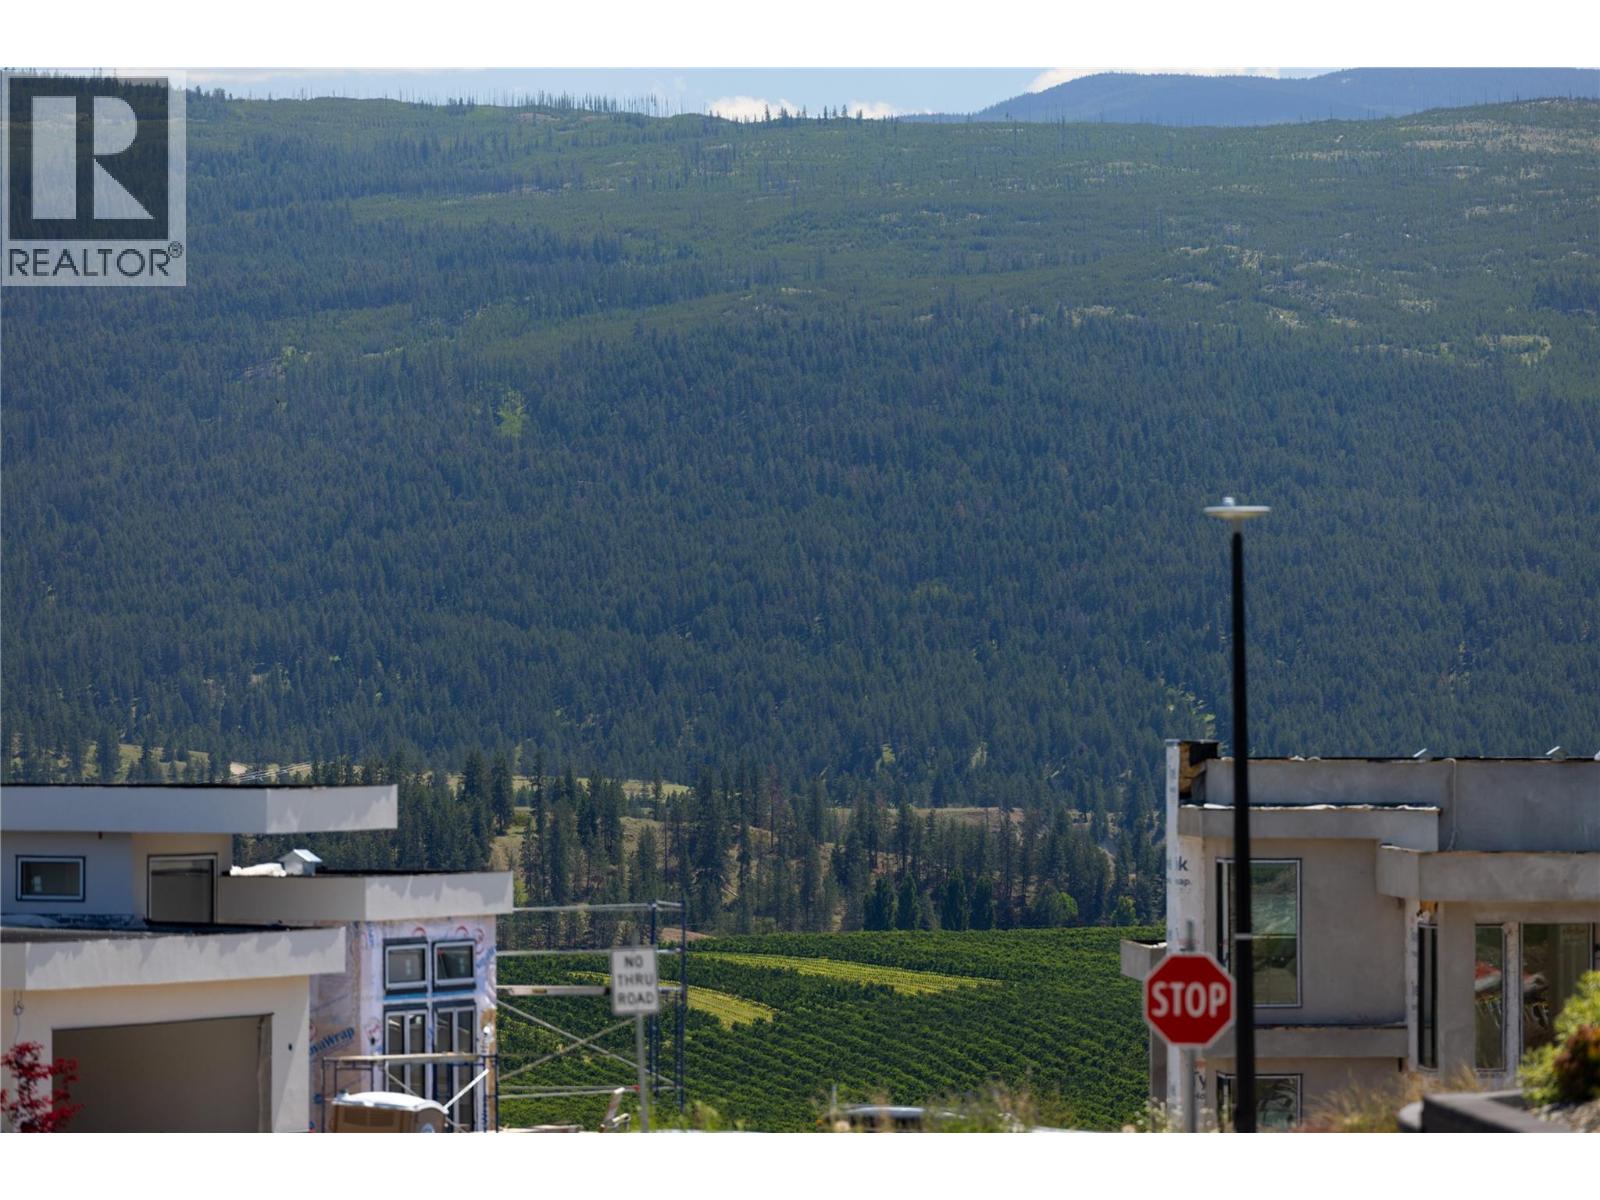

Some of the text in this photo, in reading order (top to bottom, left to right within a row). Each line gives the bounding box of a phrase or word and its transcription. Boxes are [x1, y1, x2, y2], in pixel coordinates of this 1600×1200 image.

[624, 955, 644, 968] NO
[617, 973, 654, 987] THRU
[617, 991, 655, 1005] ROAD
[1151, 980, 1228, 1019] STOP
